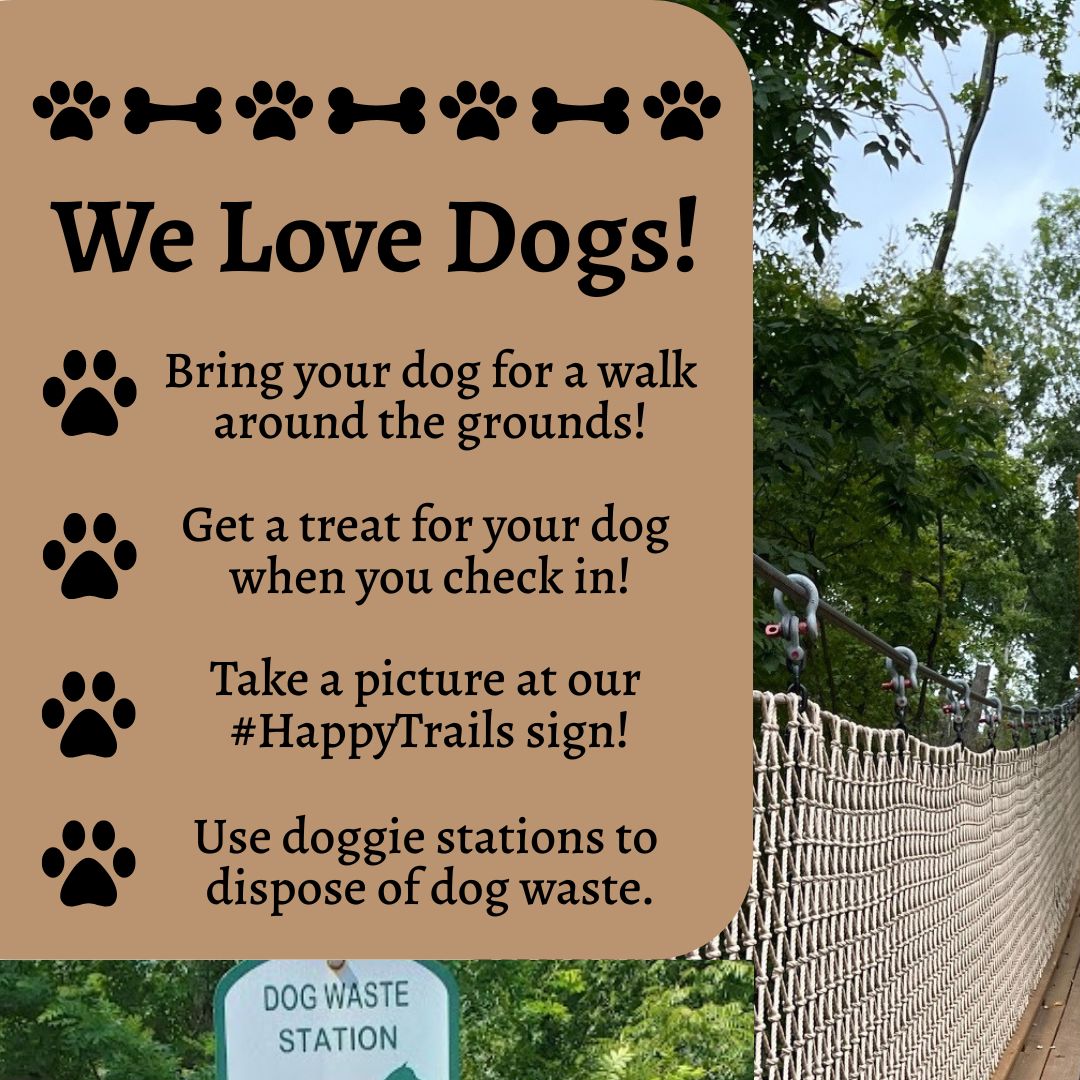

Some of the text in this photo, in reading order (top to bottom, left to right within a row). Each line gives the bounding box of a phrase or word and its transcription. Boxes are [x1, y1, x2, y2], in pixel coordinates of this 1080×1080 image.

[263, 980, 409, 1011] DOG WASTE
[279, 1025, 397, 1053] STATION
